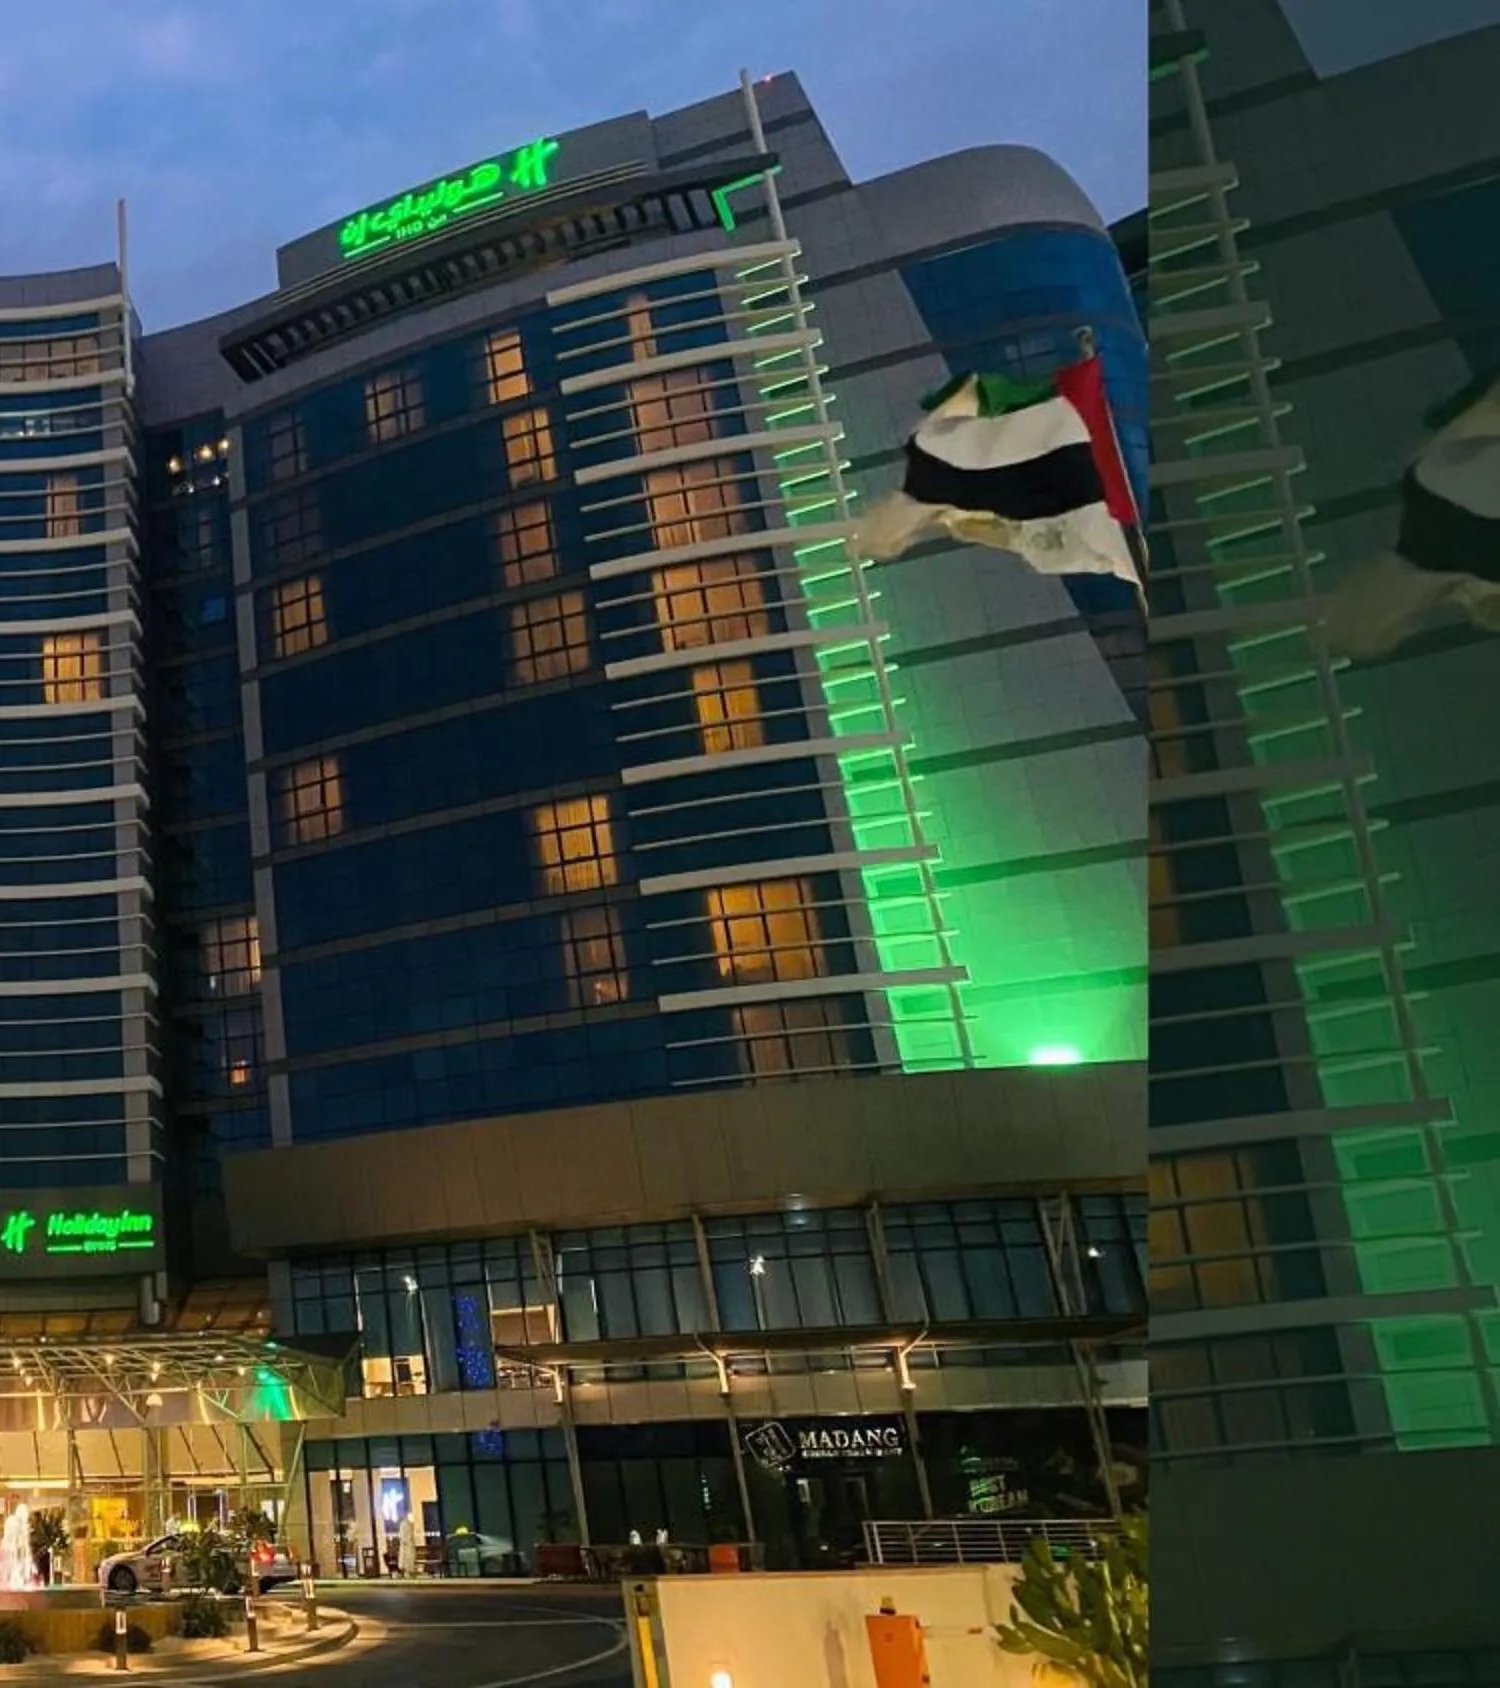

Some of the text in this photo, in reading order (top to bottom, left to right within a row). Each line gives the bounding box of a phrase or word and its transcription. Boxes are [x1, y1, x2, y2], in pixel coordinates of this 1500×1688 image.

[47, 1209, 153, 1238] Holiday Inn
[799, 1428, 899, 1449] MADANG
